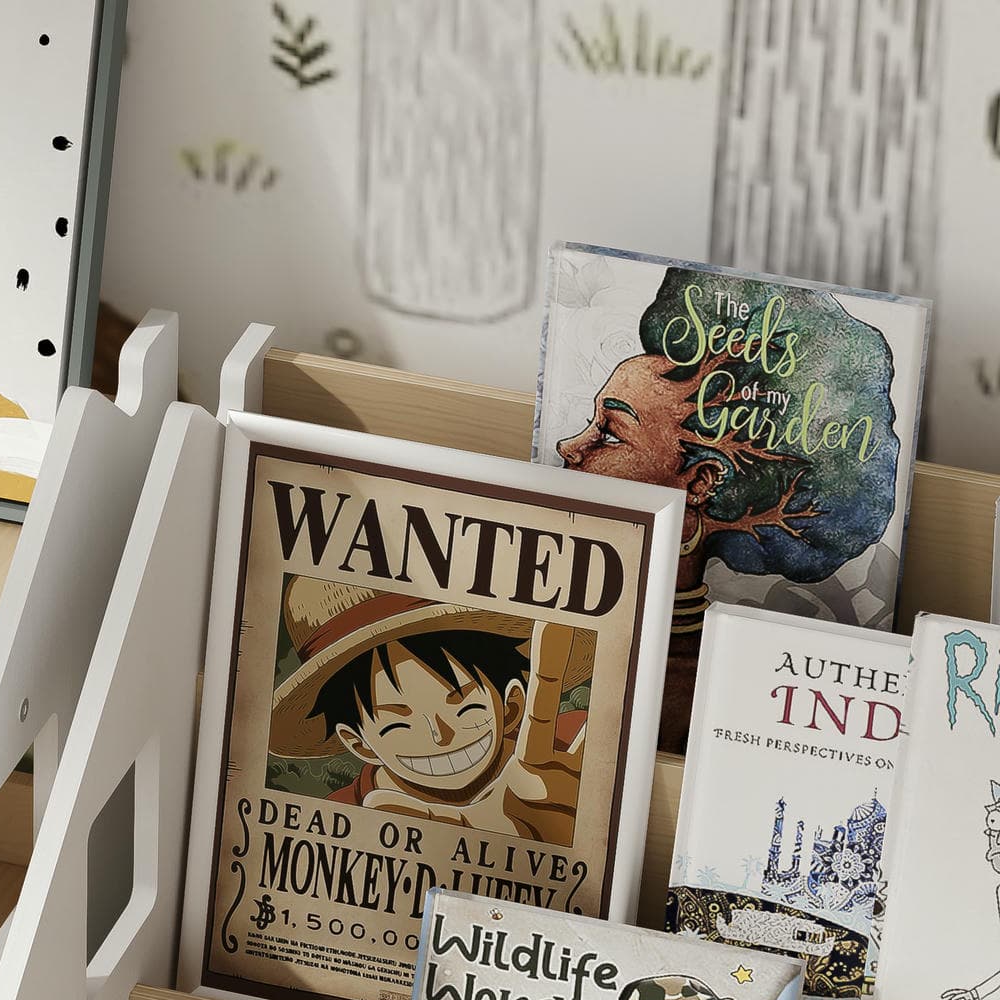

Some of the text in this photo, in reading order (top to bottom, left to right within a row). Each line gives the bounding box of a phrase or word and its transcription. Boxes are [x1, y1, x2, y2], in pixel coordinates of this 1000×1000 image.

[663, 285, 809, 378] Seeds
[715, 291, 749, 321] The
[695, 370, 882, 463] Garden
[741, 384, 791, 415] of my
[267, 480, 624, 617] WANTED
[775, 652, 907, 697] AUTHE
[771, 685, 902, 742] IND
[713, 728, 761, 746] FRESH
[766, 738, 872, 767] PERSPECTIVES
[258, 799, 569, 883] DEAD OR ALIVE
